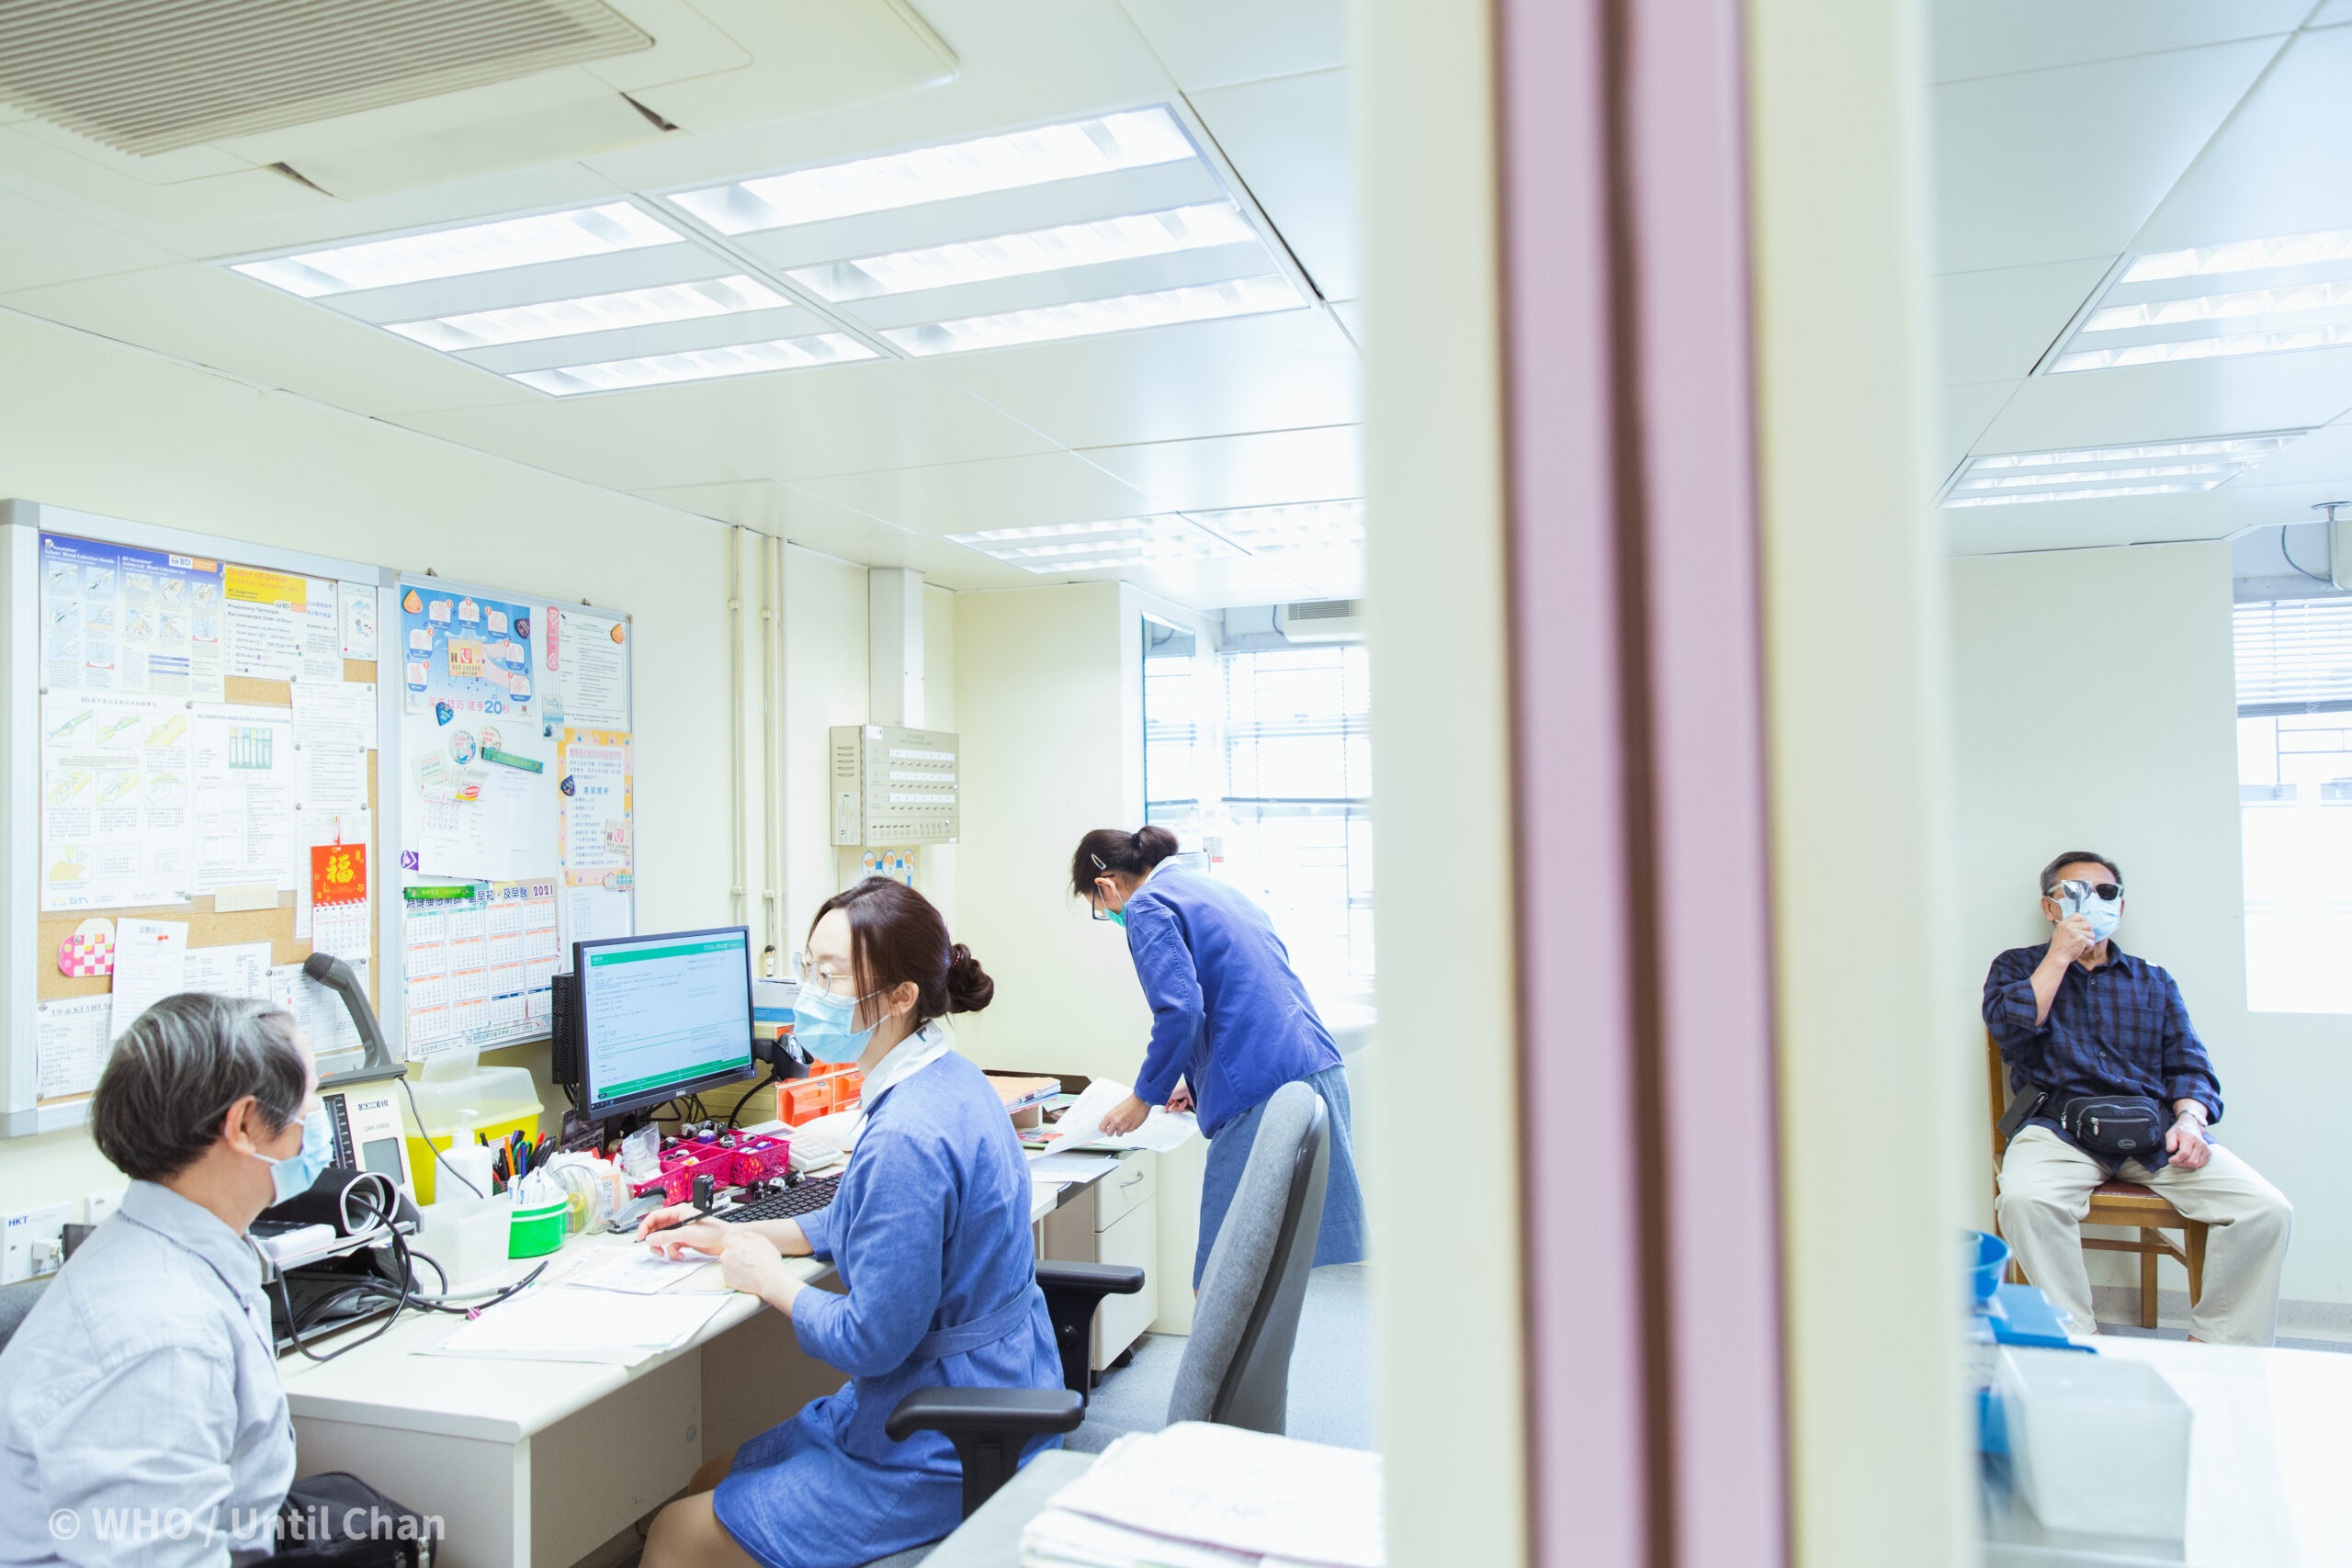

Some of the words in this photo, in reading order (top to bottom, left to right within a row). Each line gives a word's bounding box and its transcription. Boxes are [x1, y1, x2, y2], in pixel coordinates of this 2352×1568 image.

[180, 558, 190, 566] BD
[228, 568, 253, 577] Order
[266, 573, 288, 582] Draw
[326, 854, 354, 884] 福
[533, 885, 553, 897] 2021
[676, 1089, 686, 1097] DELL
[8, 1215, 28, 1227] HKT
